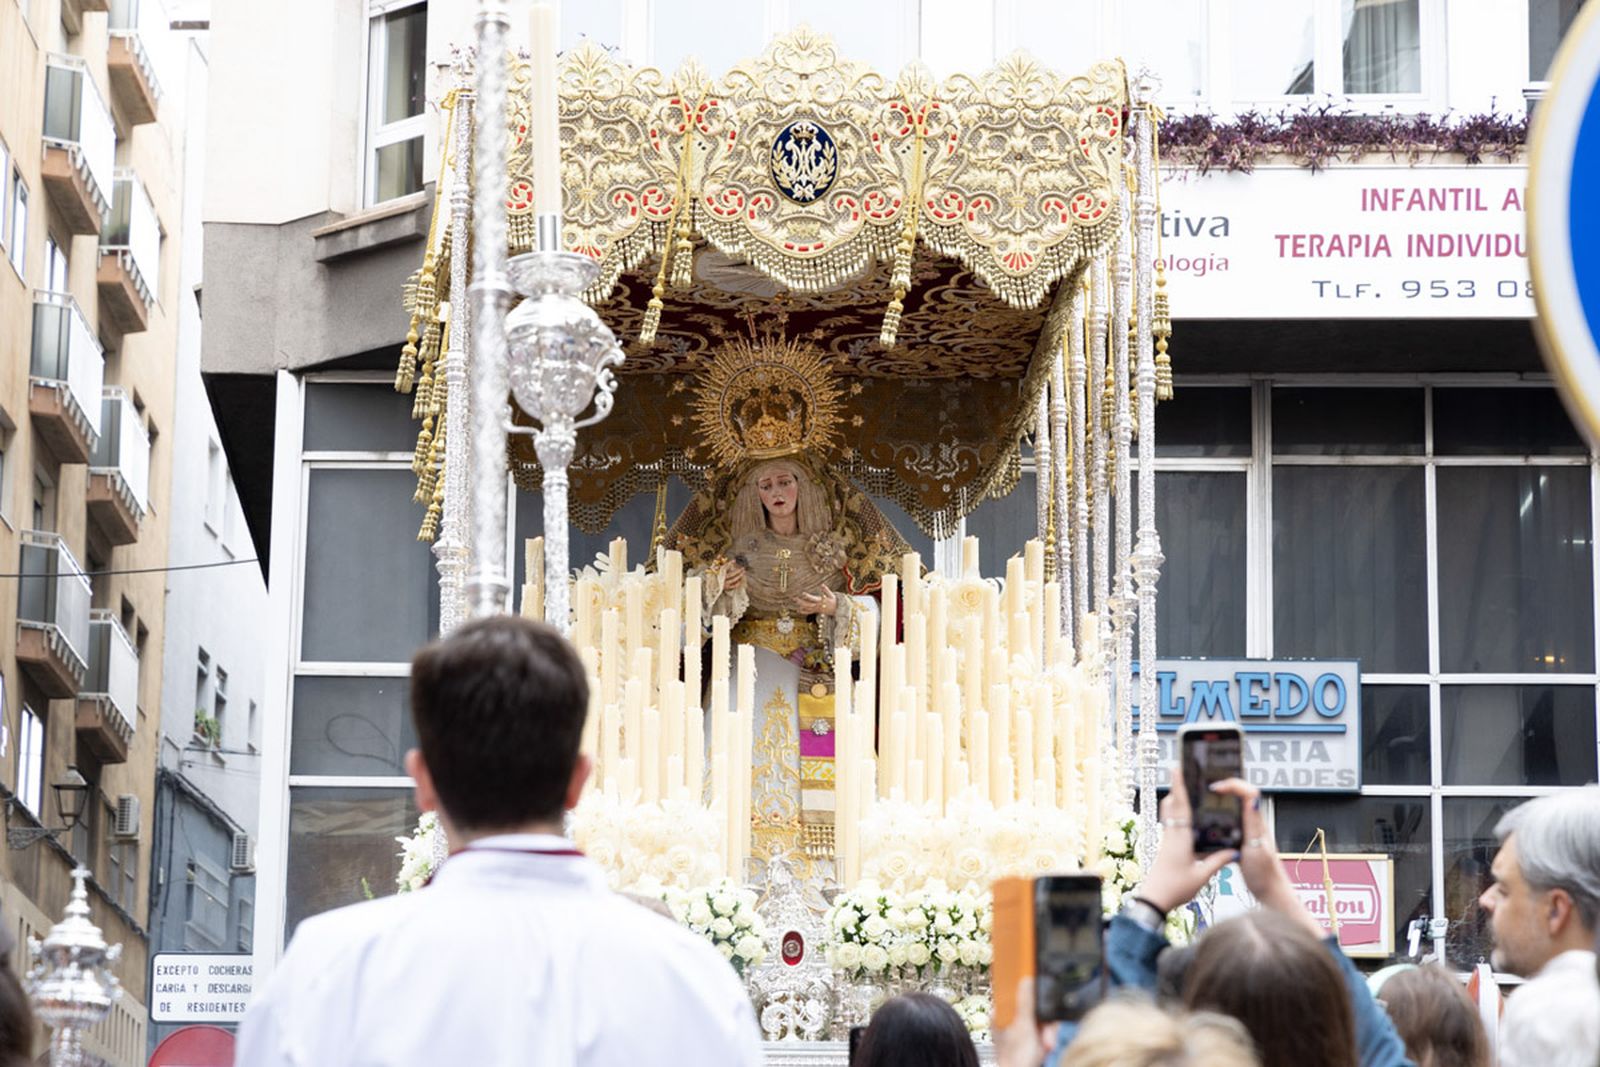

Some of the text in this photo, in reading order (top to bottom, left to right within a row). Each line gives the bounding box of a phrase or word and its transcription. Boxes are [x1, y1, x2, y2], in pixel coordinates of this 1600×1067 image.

[1361, 187, 1527, 212] INFANTIL A
[1274, 233, 1393, 259] TERAPIA
[1401, 279, 1476, 299] 953
[1130, 660, 1348, 722] LMEDO
[156, 964, 253, 976] EXCEPTO COCHERAS
[155, 983, 187, 994] CARGA
[192, 983, 199, 993] Y
[159, 1001, 247, 1013] DE RESIDENTES
